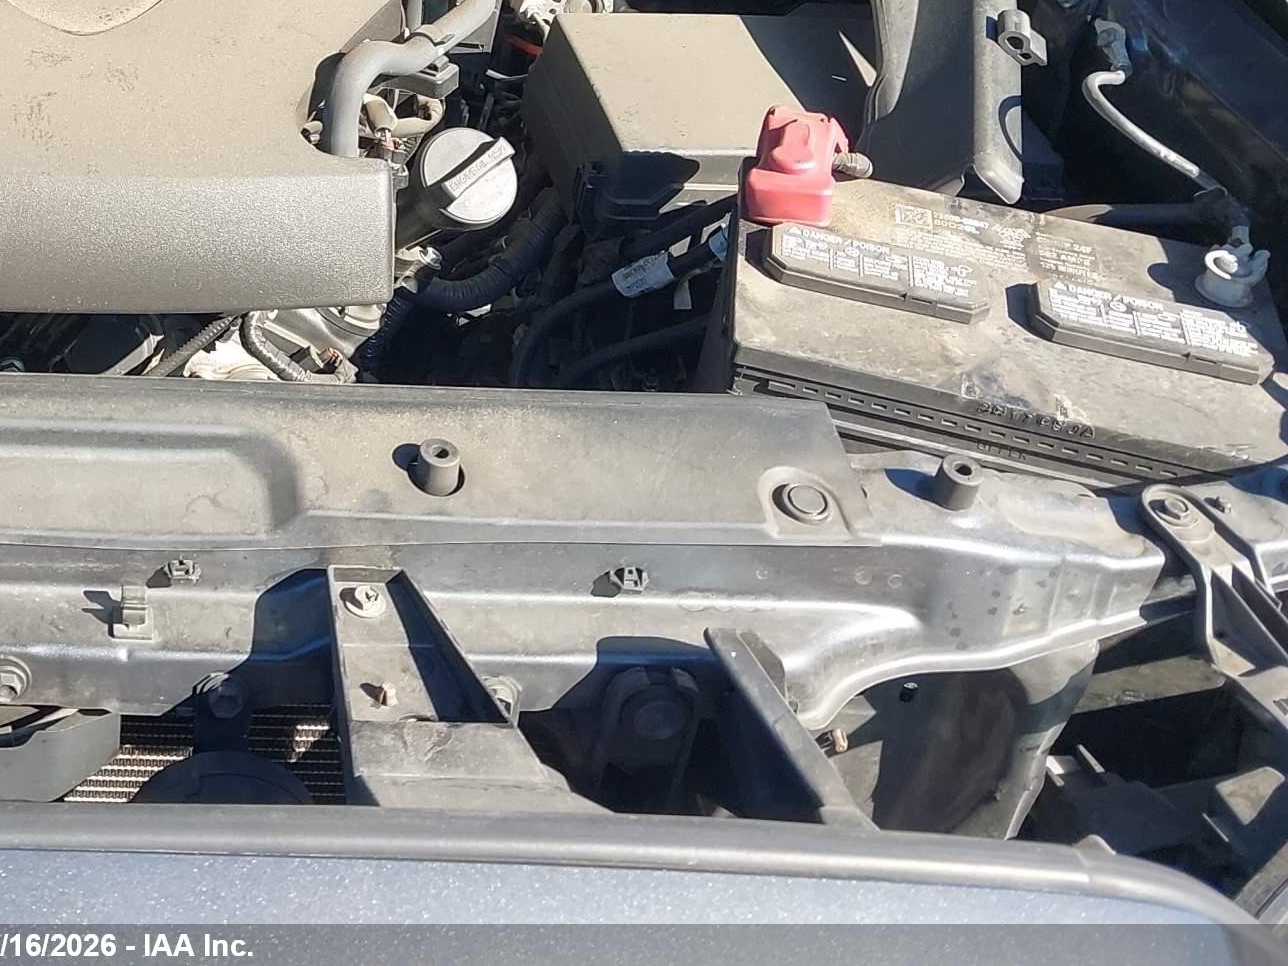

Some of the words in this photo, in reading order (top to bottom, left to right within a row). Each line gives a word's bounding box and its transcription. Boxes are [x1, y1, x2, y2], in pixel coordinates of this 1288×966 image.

[803, 229, 842, 245] DANGER
[852, 240, 890, 254] POISON
[1068, 285, 1111, 299] DANGER
[1123, 296, 1163, 310] POISON
